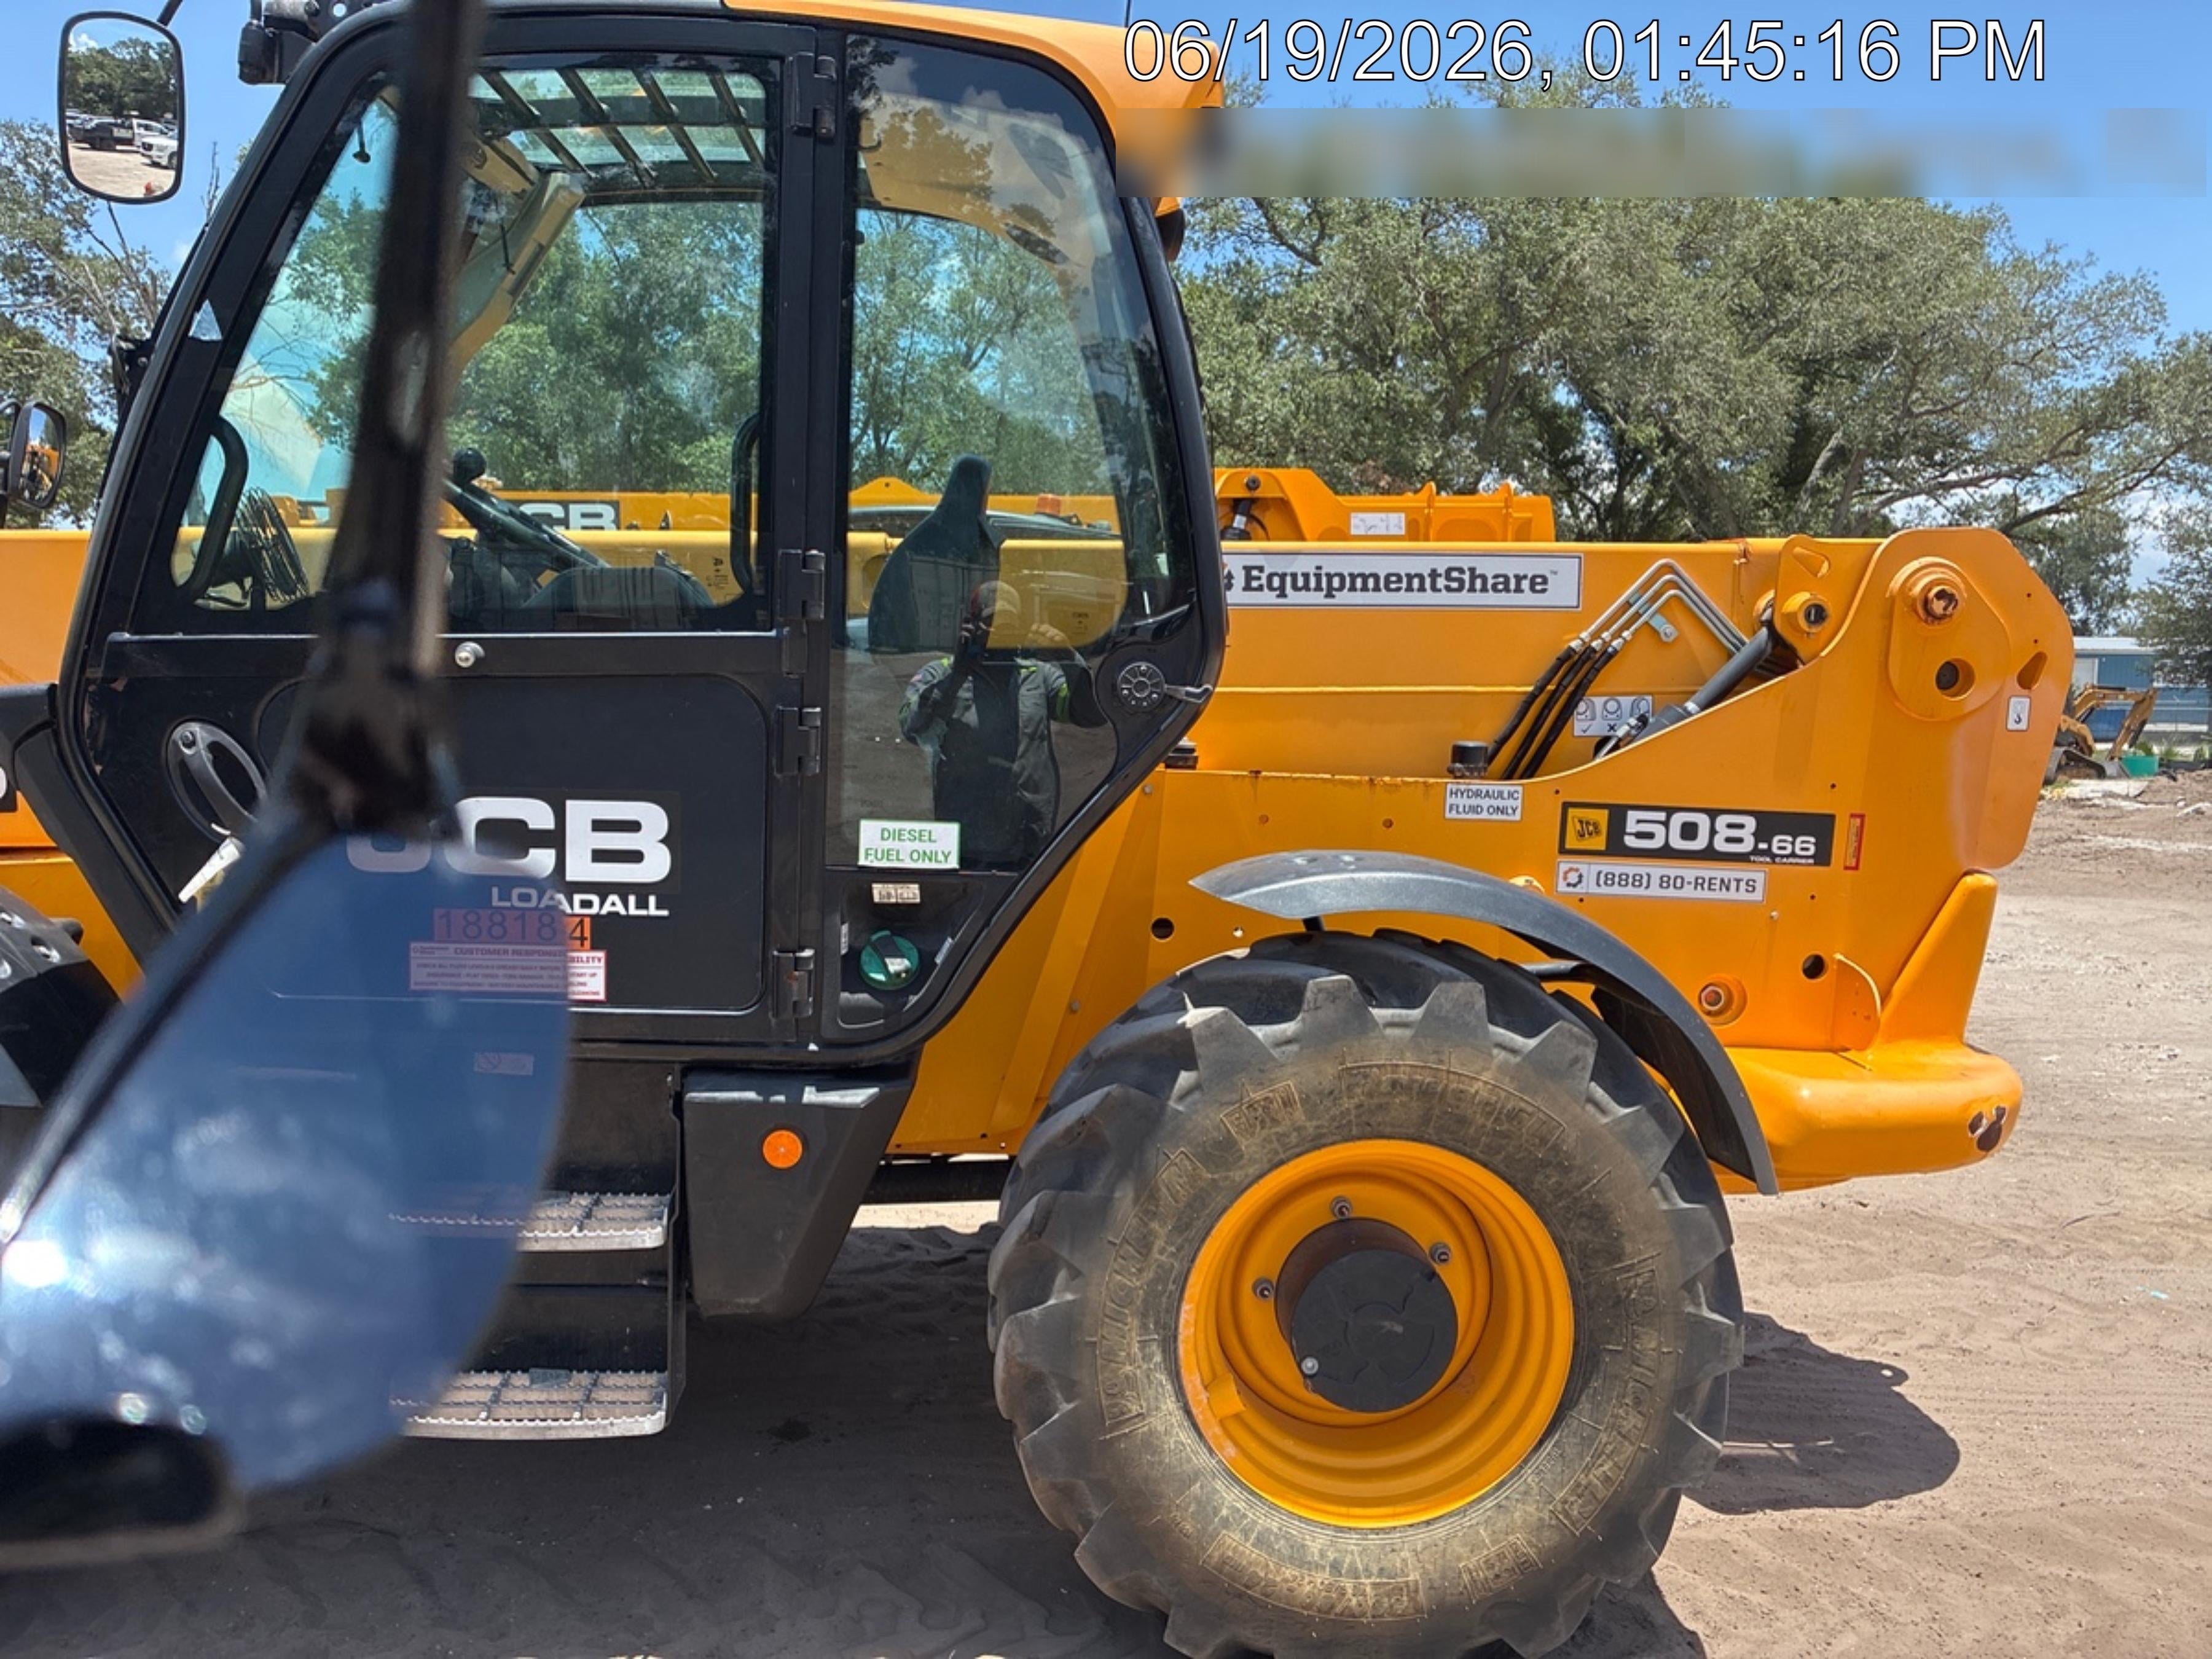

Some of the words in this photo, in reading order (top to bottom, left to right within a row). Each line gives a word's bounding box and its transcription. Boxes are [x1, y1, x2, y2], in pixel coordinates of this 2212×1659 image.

[1449, 788, 1520, 800] HYDRAULIC
[1448, 804, 1484, 815] FLUID
[1487, 805, 1519, 816] ONLY
[880, 828, 936, 842] DIESEL
[1575, 818, 1601, 838] JCB
[864, 847, 904, 861] FUEL
[909, 849, 952, 863] ONLY
[1596, 870, 1652, 890] (888)
[1658, 873, 1757, 894] 80-RENTS
[492, 886, 670, 916] LOADALL
[437, 910, 589, 947] 188184
